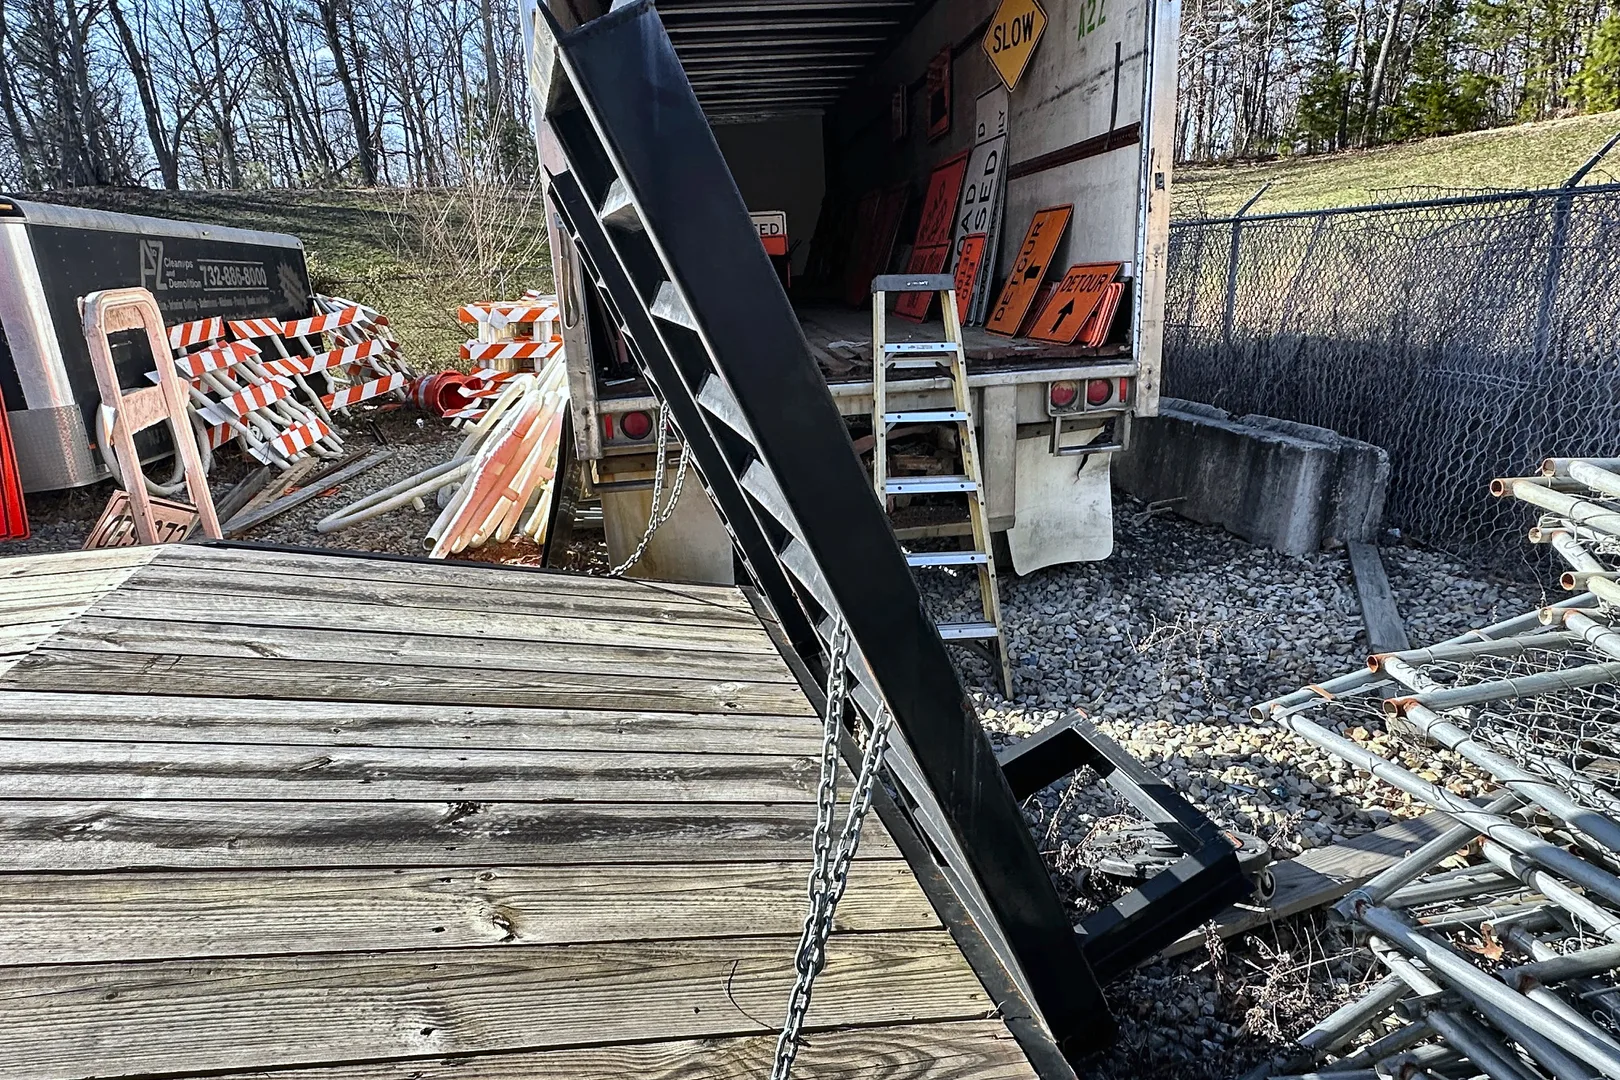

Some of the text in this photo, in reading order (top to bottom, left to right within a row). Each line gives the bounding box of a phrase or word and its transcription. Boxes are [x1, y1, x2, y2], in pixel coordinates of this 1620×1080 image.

[993, 10, 1035, 54] SLOW
[975, 150, 998, 230] SED
[755, 223, 780, 236] ED
[169, 278, 202, 289] Demolition
[199, 265, 267, 286] 732-886-8000
[955, 243, 973, 298] DETO
[961, 261, 976, 300] END
[994, 221, 1045, 322] DETOUR
[1060, 272, 1109, 293] DETOUR
